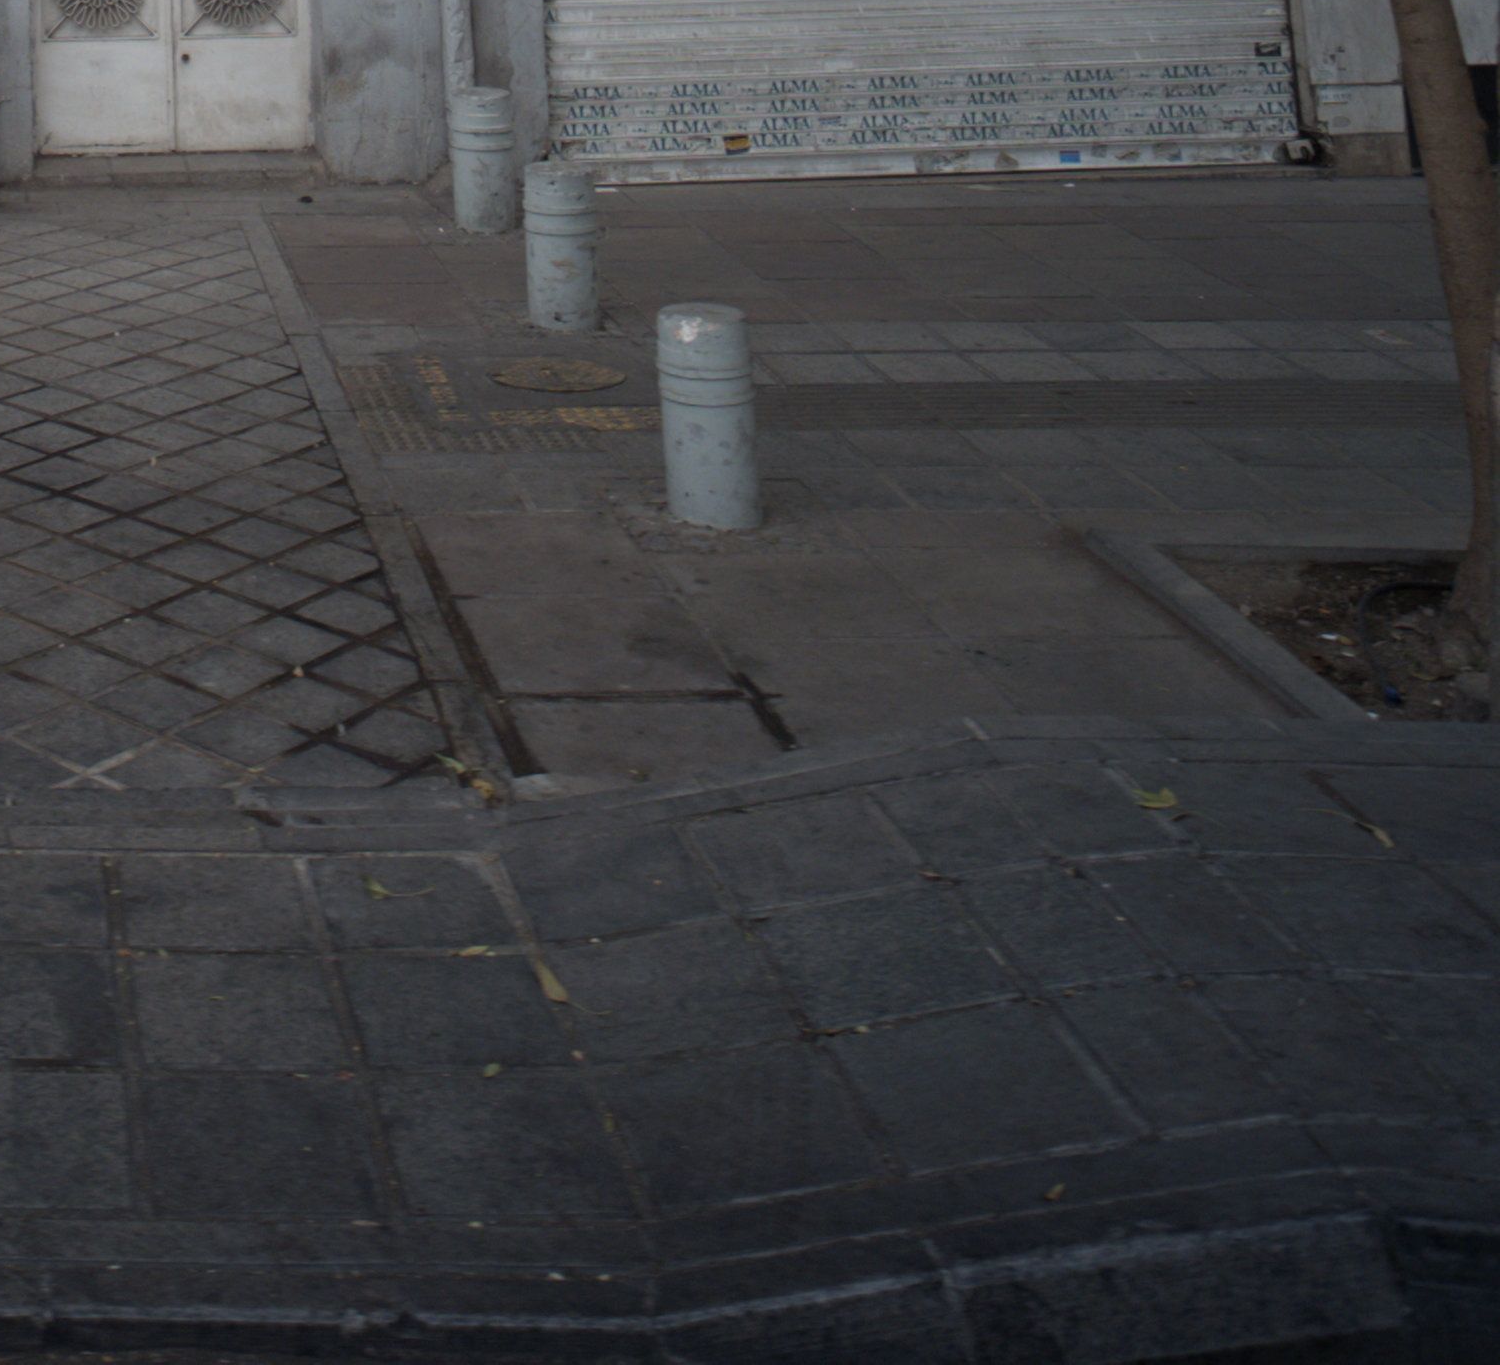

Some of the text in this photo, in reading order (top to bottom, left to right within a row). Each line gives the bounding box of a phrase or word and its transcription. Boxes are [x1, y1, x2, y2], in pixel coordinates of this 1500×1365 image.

[572, 86, 621, 99] ALMA
[670, 84, 721, 97] ALMA
[770, 79, 820, 94] ALMA
[868, 76, 918, 89] ALMA
[965, 72, 1015, 87] ALMA
[1064, 69, 1114, 83] ALMA
[1160, 65, 1212, 79] ALMA
[567, 105, 619, 119] ALMA
[667, 102, 719, 115] ALMA
[769, 99, 820, 113] ALMA
[867, 95, 920, 110] ALMA
[967, 91, 1018, 105] ALMA
[1067, 87, 1118, 101] ALMA
[559, 123, 610, 136] ALMA
[660, 120, 711, 134] ALMA
[760, 116, 811, 131] ALMA
[960, 112, 1010, 125] ALMA
[1059, 108, 1108, 121] ALMA
[1157, 105, 1207, 119] ALMA
[750, 133, 800, 148] ALMA
[849, 130, 900, 144] ALMA
[948, 126, 999, 141] ALMA
[1048, 124, 1099, 138] ALMA
[1146, 122, 1197, 135] ALMA
